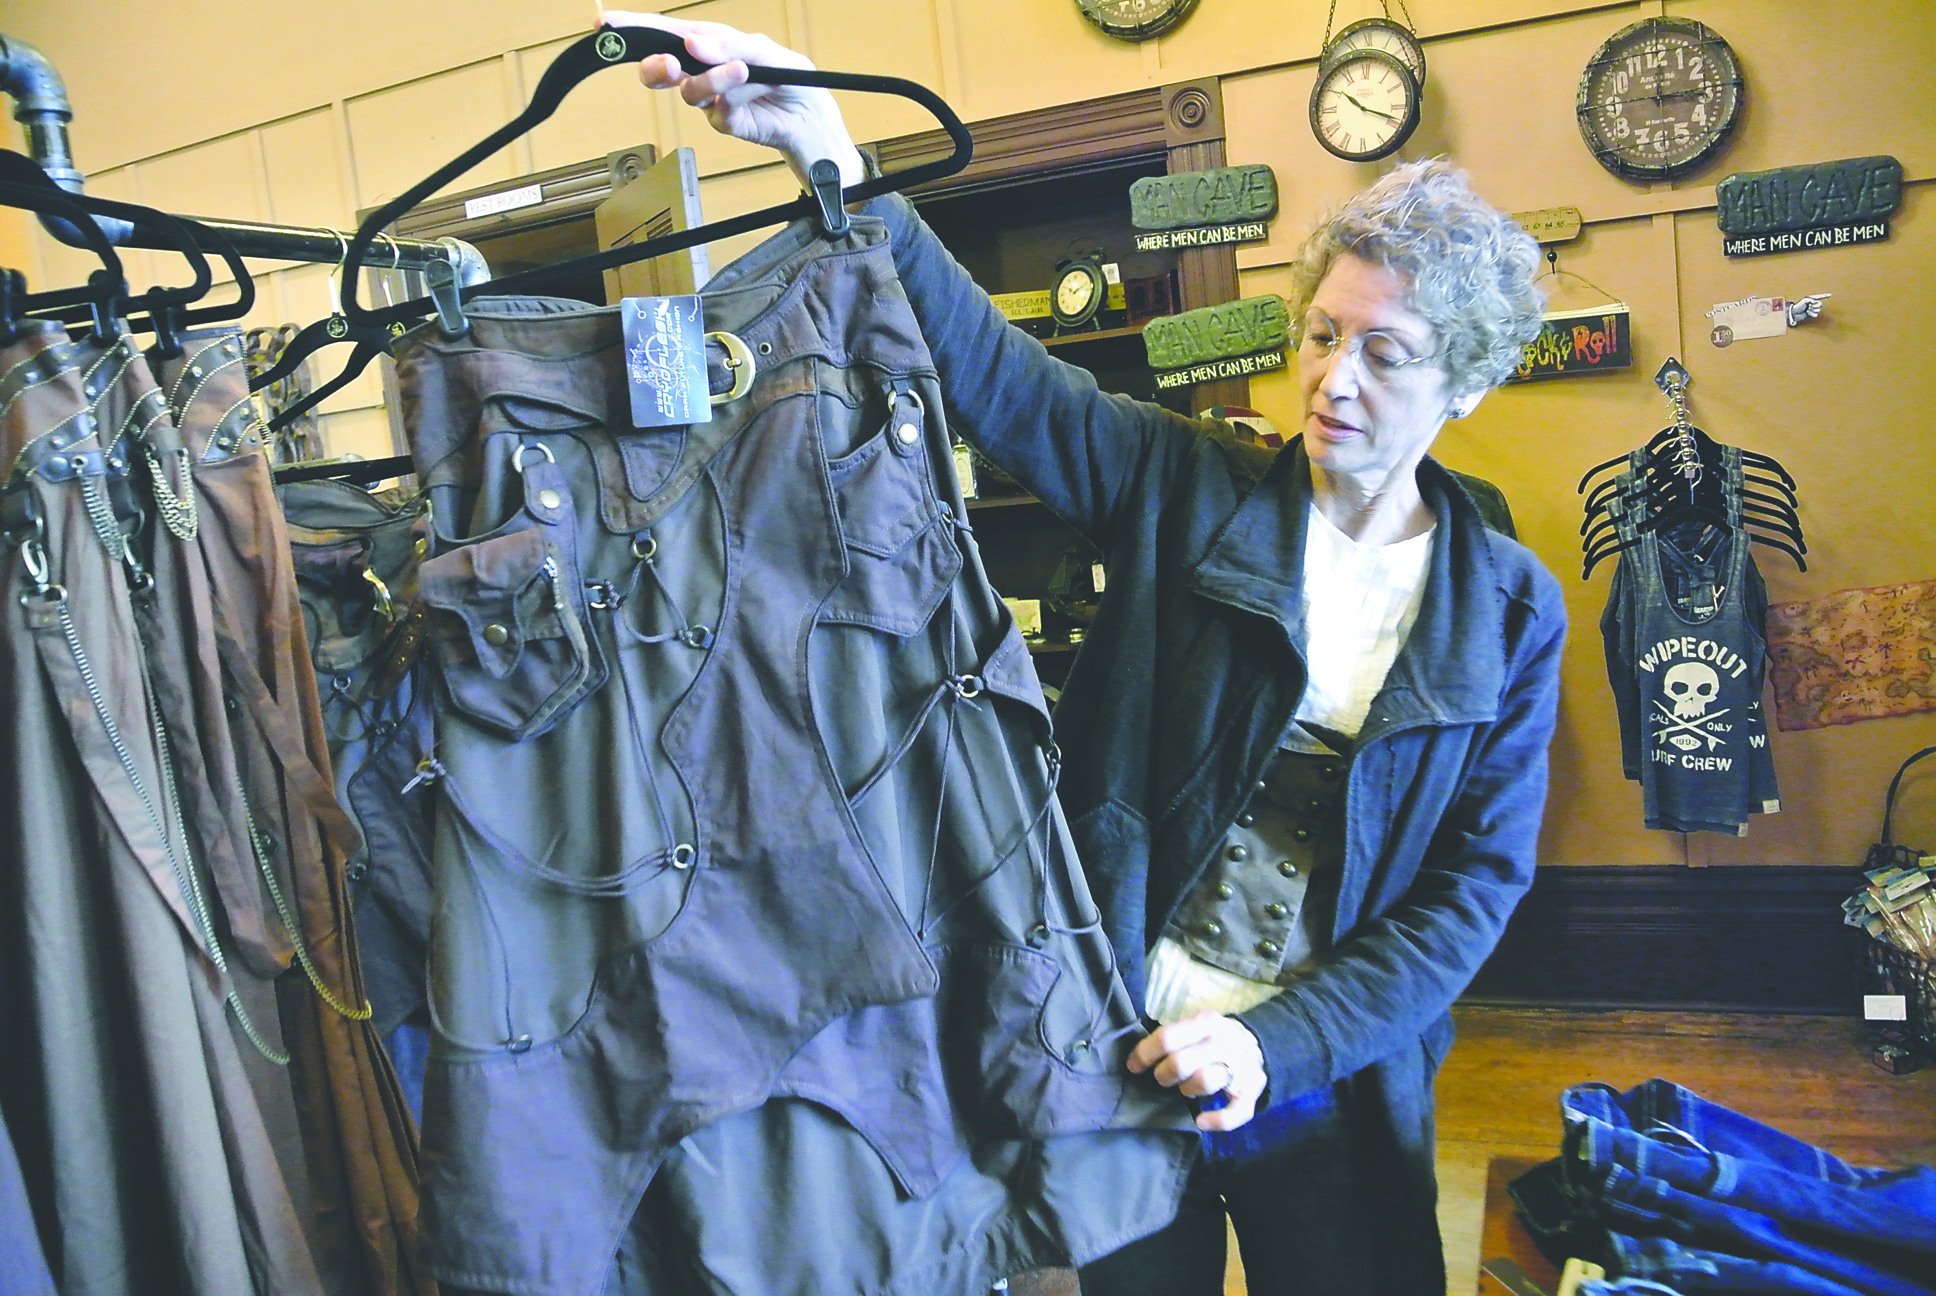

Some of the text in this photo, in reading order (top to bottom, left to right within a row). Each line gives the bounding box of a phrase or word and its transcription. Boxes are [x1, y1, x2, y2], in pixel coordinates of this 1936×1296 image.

[1626, 56, 1642, 77] 11
[1644, 44, 1668, 69] 12
[1675, 48, 1684, 70] 1
[1688, 57, 1704, 81] 2
[1691, 103, 1707, 126] 4
[1613, 117, 1630, 139] 8
[1673, 122, 1690, 145] 5
[1653, 130, 1670, 152] 6
[1133, 169, 1268, 222] MAN CAVE
[1721, 165, 1893, 229] MAN CAVE
[1136, 223, 1263, 250] WHERE MEN CAN BE MEN
[1726, 223, 1885, 254] WHERE MEN CAN BE MEN
[1703, 295, 1759, 319] POSTCARDS
[1147, 300, 1283, 359] MAN CAVE
[1157, 352, 1281, 388] WHERE MEN CAN BE MEN
[1639, 637, 1747, 679] WIPEOUT
[1706, 721, 1733, 733] ONLY
[1675, 738, 1698, 747] 1992
[1682, 755, 1733, 772] CREW
